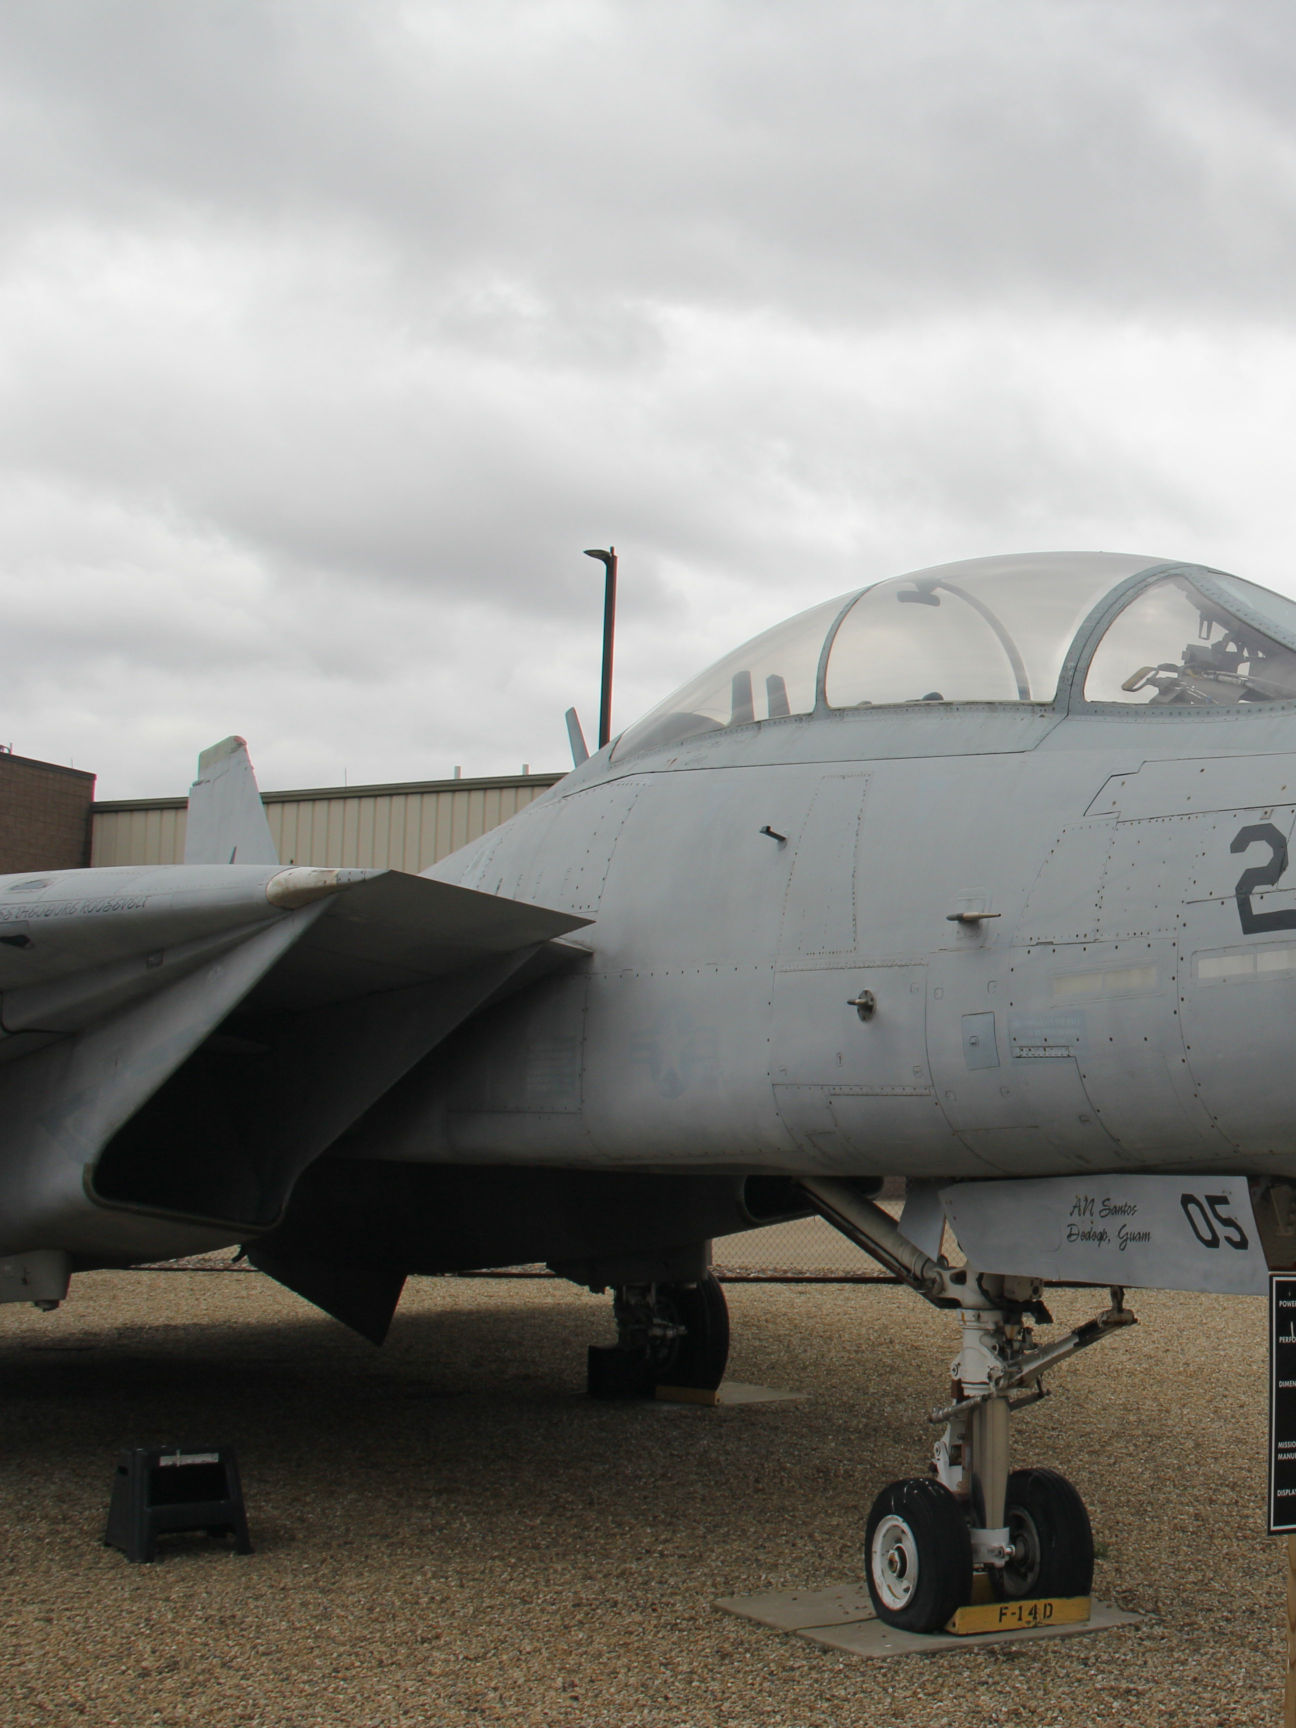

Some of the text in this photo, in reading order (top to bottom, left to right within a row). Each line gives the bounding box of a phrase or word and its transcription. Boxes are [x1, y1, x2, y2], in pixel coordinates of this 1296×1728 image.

[1099, 1198, 1137, 1218] Santos
[1180, 1193, 1248, 1250] 05
[1118, 1224, 1151, 1251] Guam
